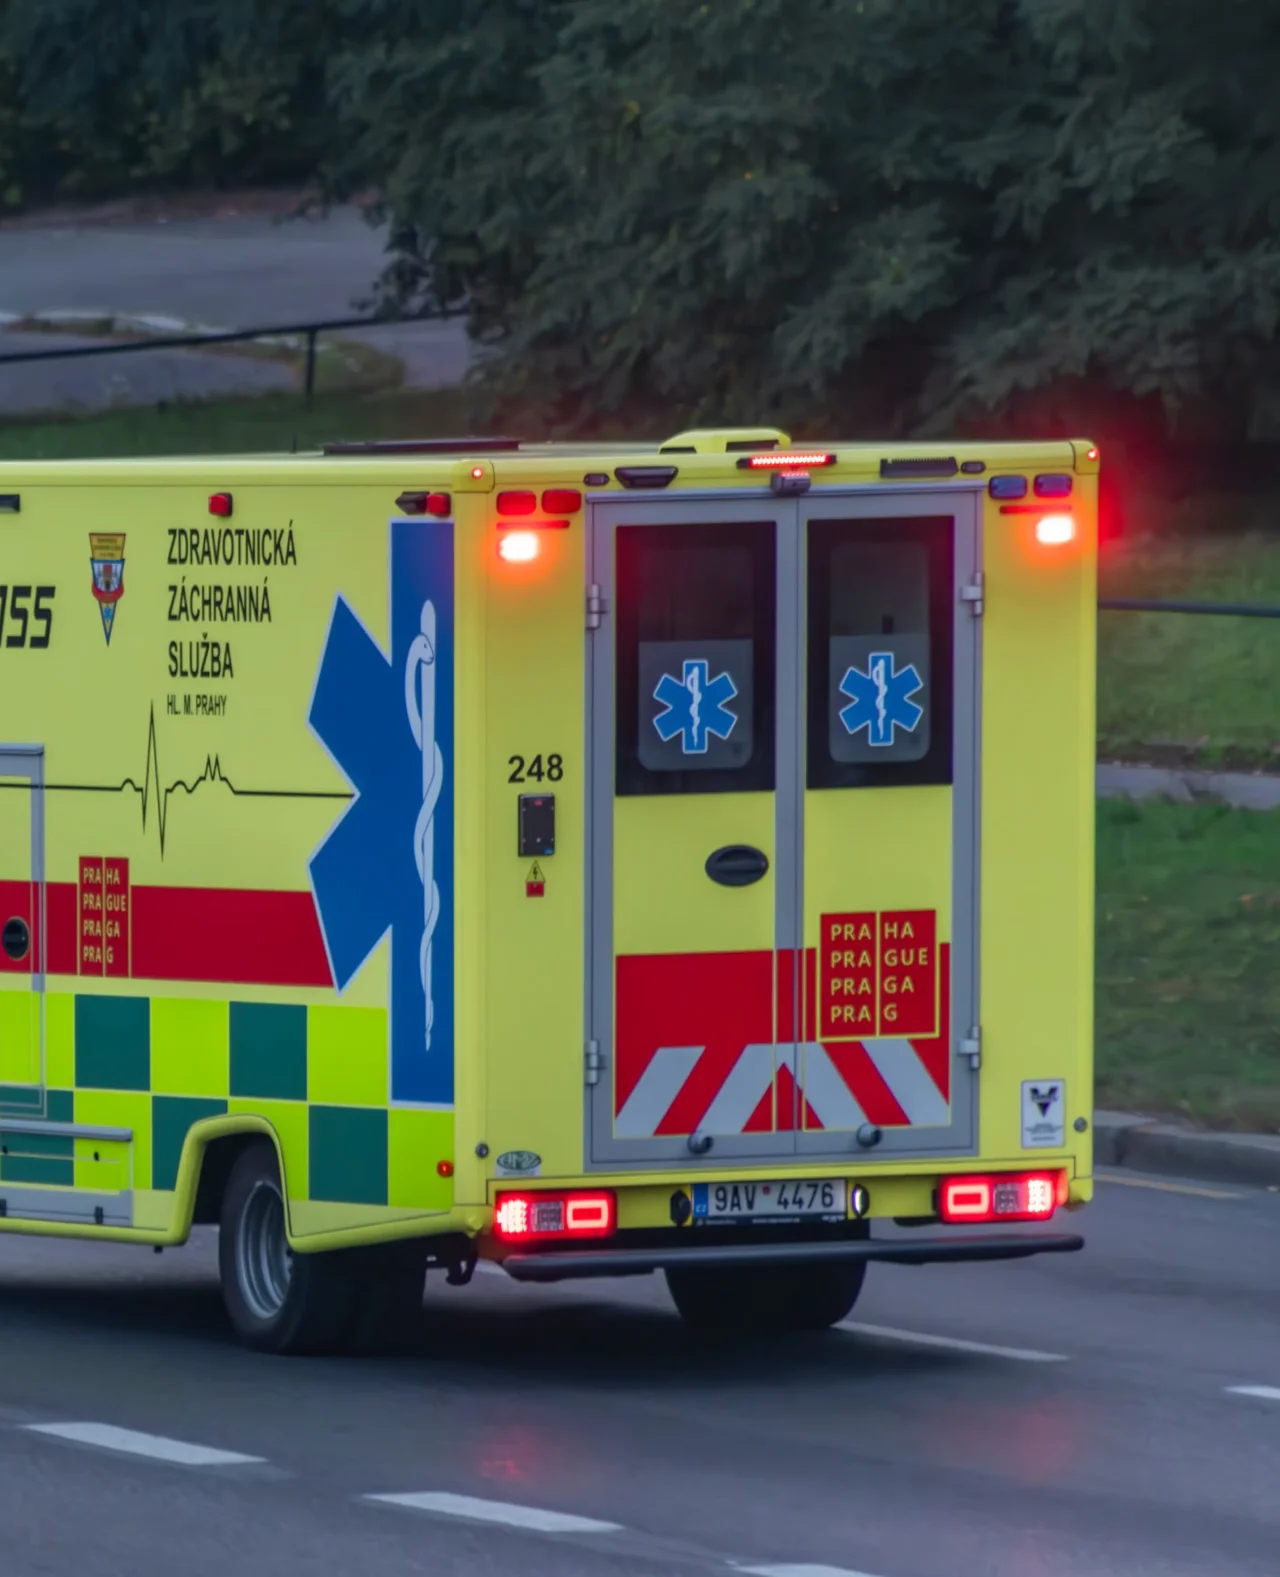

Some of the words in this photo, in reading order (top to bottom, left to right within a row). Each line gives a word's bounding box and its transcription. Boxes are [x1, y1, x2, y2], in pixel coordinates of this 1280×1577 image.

[167, 519, 297, 566] ZDRAVOTNICKÁ
[168, 576, 272, 623] ZÁCHRANNÁ
[168, 632, 234, 678] SLUŽBA
[167, 694, 181, 716] HL.
[183, 694, 194, 716] M.
[196, 694, 227, 716] PRAHY
[508, 754, 563, 783] 248
[715, 1184, 756, 1212] 9AV
[777, 1182, 834, 1210] 4476
